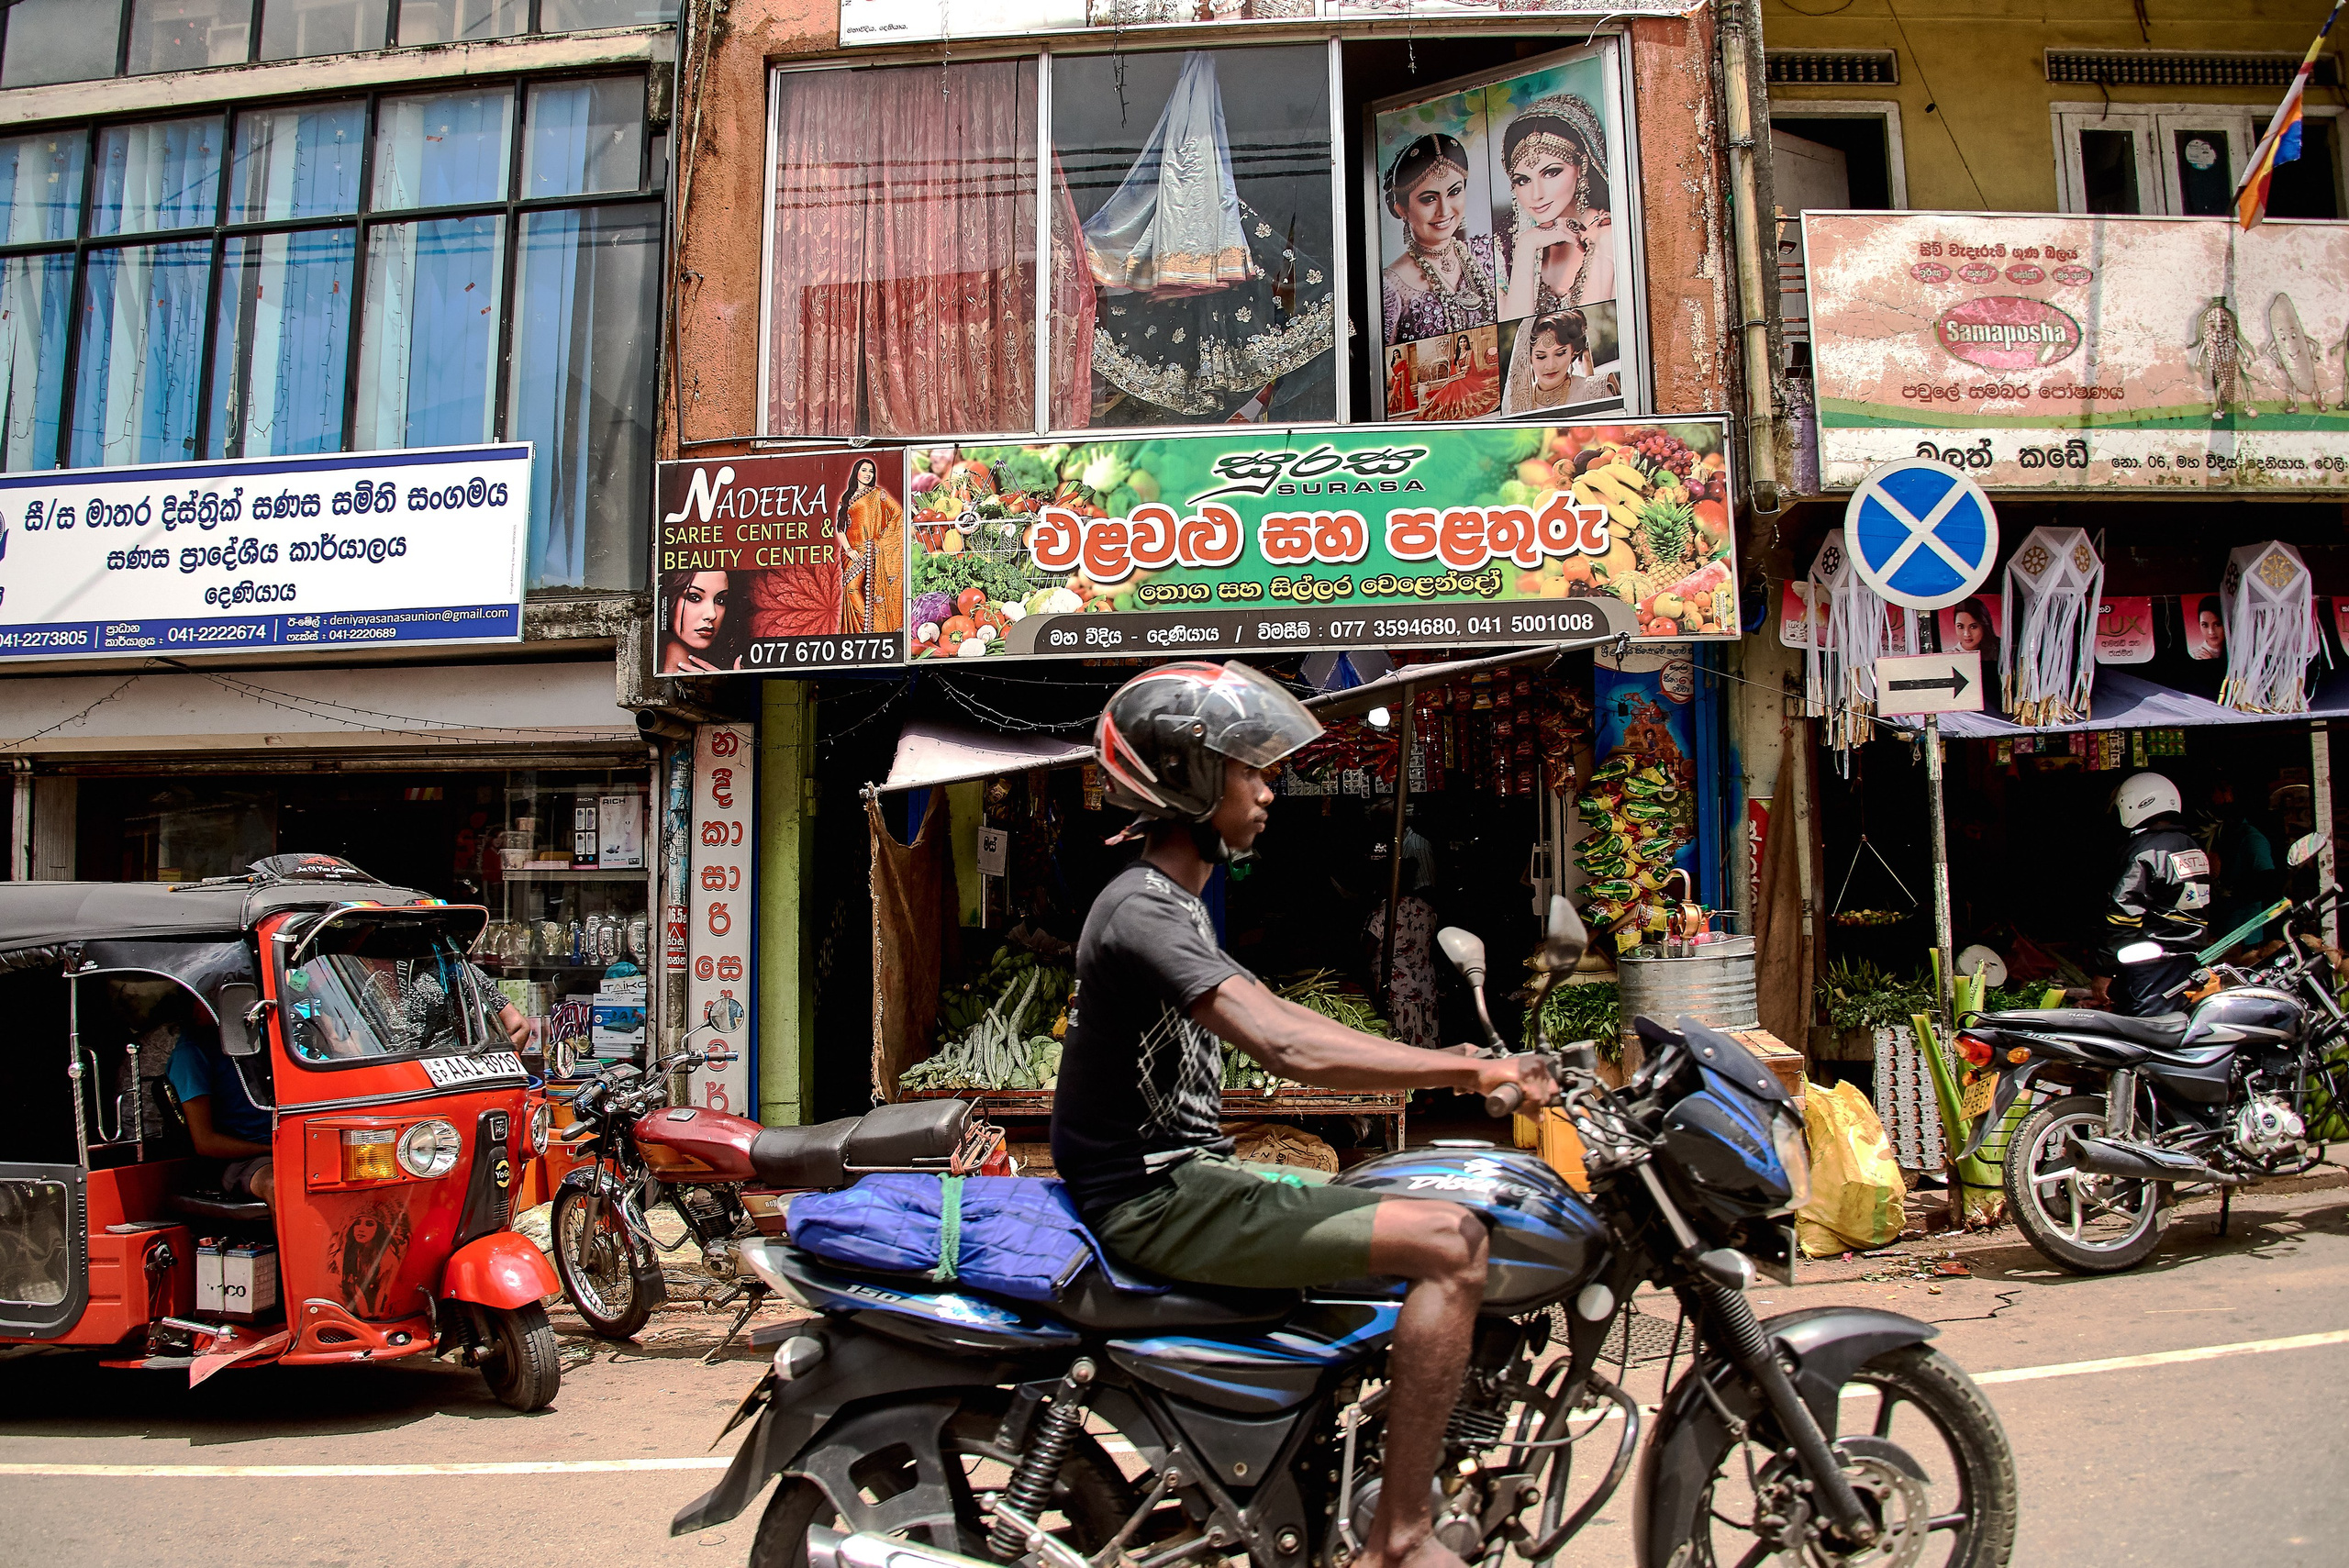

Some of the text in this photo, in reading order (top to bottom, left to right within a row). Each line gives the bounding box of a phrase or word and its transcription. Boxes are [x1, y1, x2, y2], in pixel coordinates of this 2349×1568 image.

[1946, 320, 2065, 350] Samaposha
[1901, 383, 2125, 402] පවුලේ සමබර පෝෂණය
[2019, 439, 2088, 469] කඩේ
[2147, 456, 2171, 471] 06,
[2176, 457, 2199, 469] මහ
[1277, 478, 1427, 495] SURASA
[86, 495, 151, 528] මාතර
[252, 488, 320, 519] සණස
[332, 480, 396, 516] සමිති
[407, 476, 507, 511] සංගමය
[664, 517, 834, 545] SAREE CENTER &
[1030, 493, 1607, 581] එළවළු සහ පළතුරු
[107, 544, 170, 570] සණස
[289, 532, 406, 563] කාර්යාලය
[664, 545, 835, 571] BEAUTY CENTER
[205, 580, 296, 609] දෙණියාය
[1139, 569, 1502, 601] තොග සහ සිල්ලර වෙළෙන්දෝ
[329, 607, 509, 627] deniyayasanasaunion@gmail.com
[168, 624, 266, 642] 041-2222674
[328, 628, 396, 640] 041-2220689
[1049, 629, 1078, 646] මහ
[1085, 627, 1122, 648] වීදිය
[1147, 626, 1219, 648] දෙණියාය
[1257, 621, 1311, 640] විමසීම්
[1330, 620, 1365, 639] 077
[1373, 617, 1462, 638] 3594680,
[1467, 616, 1502, 634] 041
[1510, 614, 1595, 633] 5001008
[750, 639, 895, 663] 077 670 8775
[846, 1284, 902, 1303] 150
